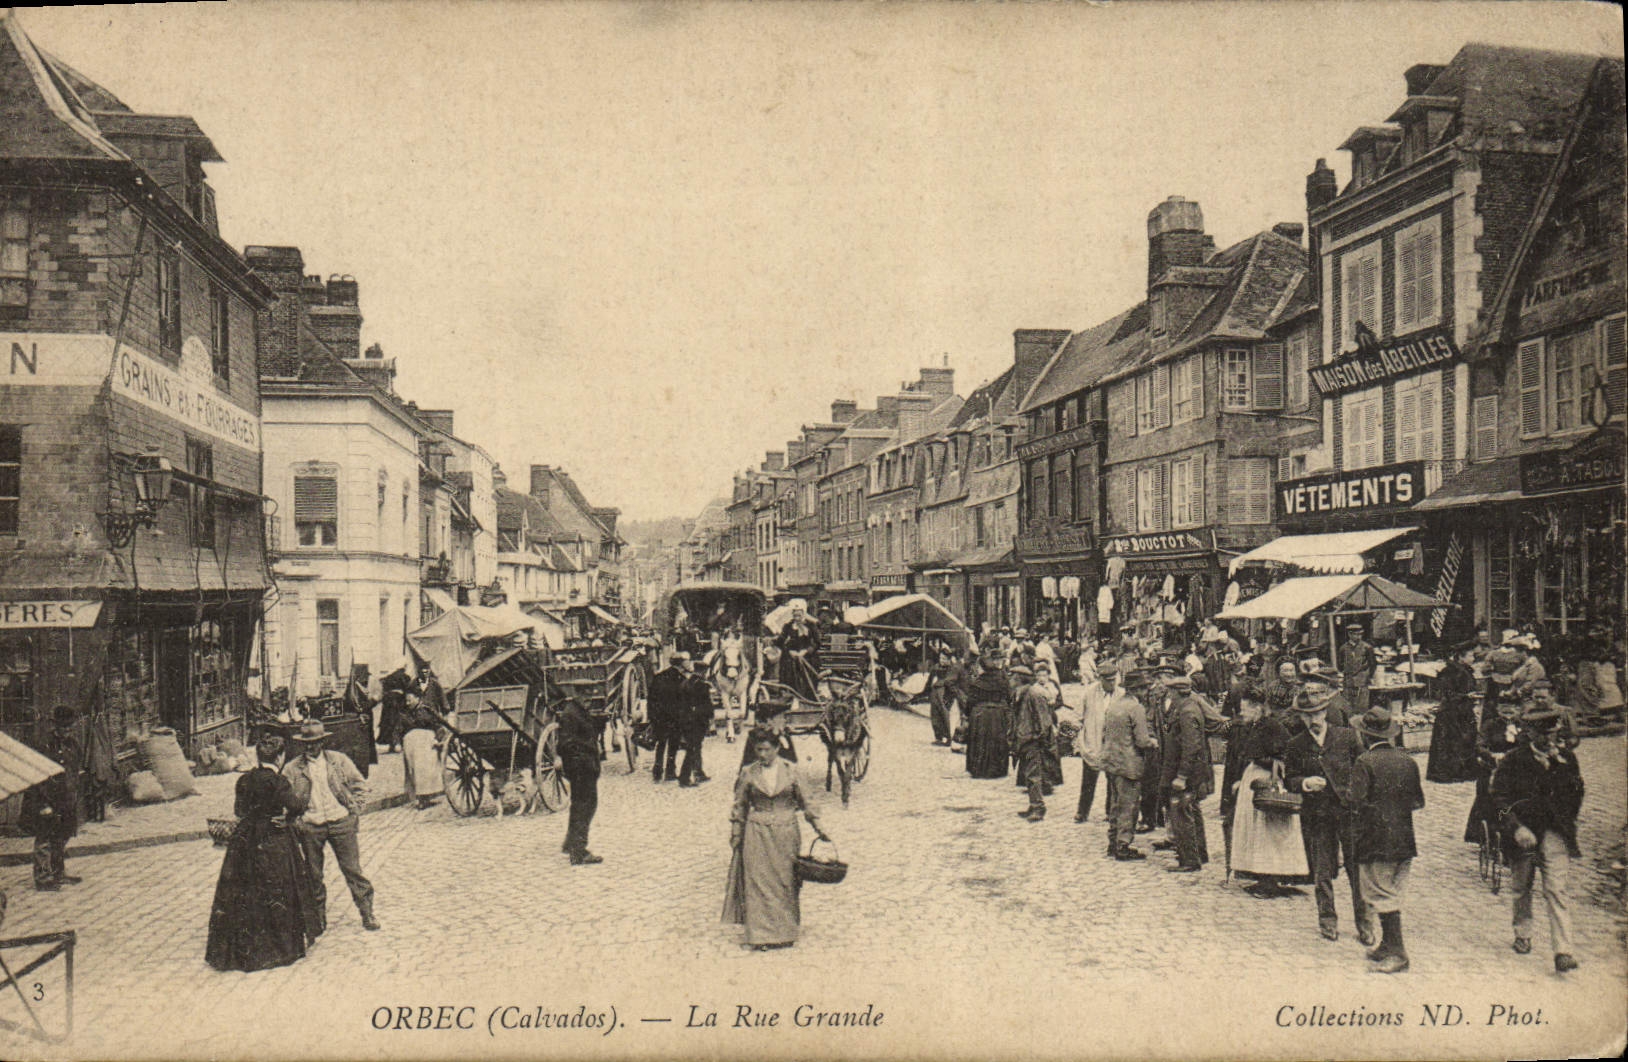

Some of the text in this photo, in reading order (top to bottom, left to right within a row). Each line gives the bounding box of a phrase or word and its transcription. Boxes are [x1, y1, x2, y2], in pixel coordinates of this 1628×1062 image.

[10, 342, 37, 375] N
[1312, 335, 1453, 393] MAISON des ABEILLES
[120, 352, 171, 407] GRAINS
[197, 392, 256, 446] FOURRAGES
[1283, 472, 1413, 514] VÊTEMENTS
[1130, 534, 1186, 552] BOUCTOT
[0, 600, 73, 622] ÈRES
